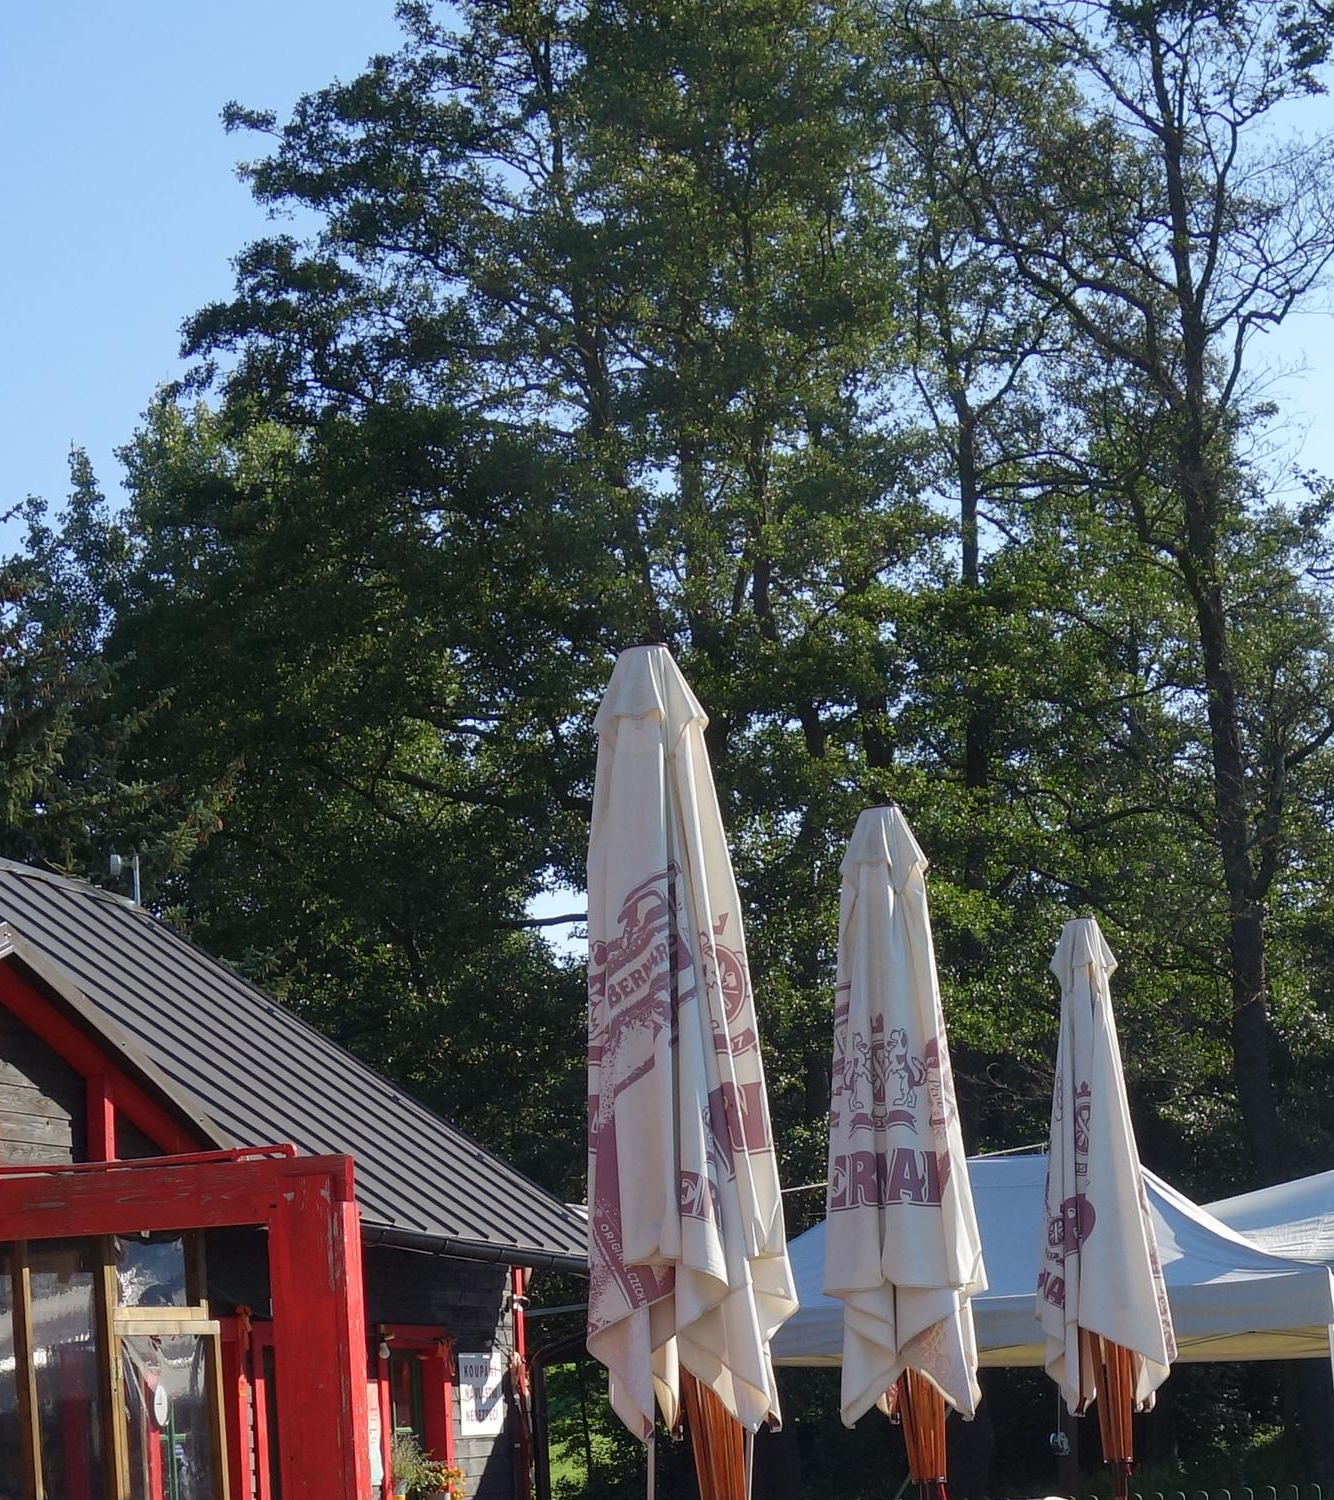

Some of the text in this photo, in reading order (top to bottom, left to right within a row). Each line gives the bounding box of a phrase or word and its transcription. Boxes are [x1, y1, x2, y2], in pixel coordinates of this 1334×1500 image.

[608, 943, 670, 1009] BERNAR
[601, 1223, 646, 1300] ORIGIL CZECH
